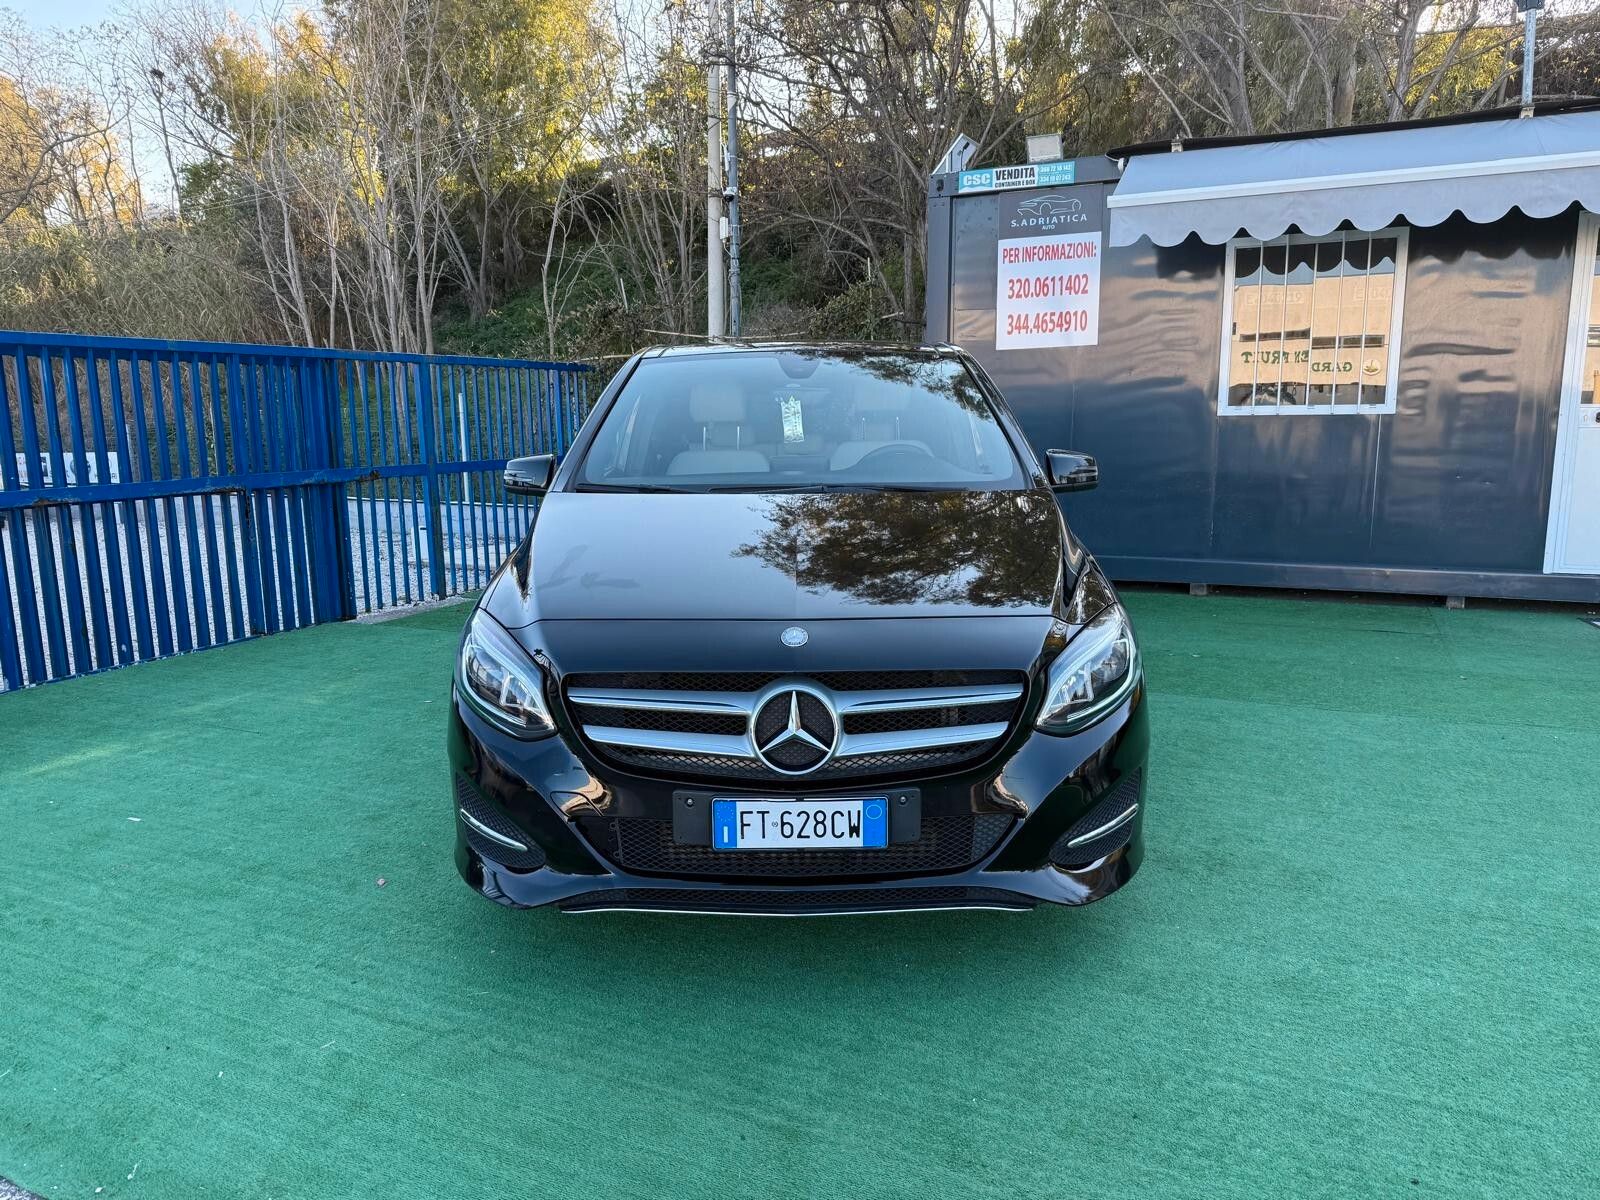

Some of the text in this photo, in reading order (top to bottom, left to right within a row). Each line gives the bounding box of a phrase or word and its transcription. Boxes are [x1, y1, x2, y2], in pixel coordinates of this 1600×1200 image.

[963, 173, 991, 186] CSC
[995, 167, 1036, 181] VENDITA
[995, 180, 1021, 189] CONTAINER
[1011, 213, 1088, 228] S.ADRIATICA
[1003, 241, 1097, 264] PER INFORMAZIONI:
[1008, 273, 1089, 299] 320.0611402
[1007, 309, 1088, 336] 344.4654910
